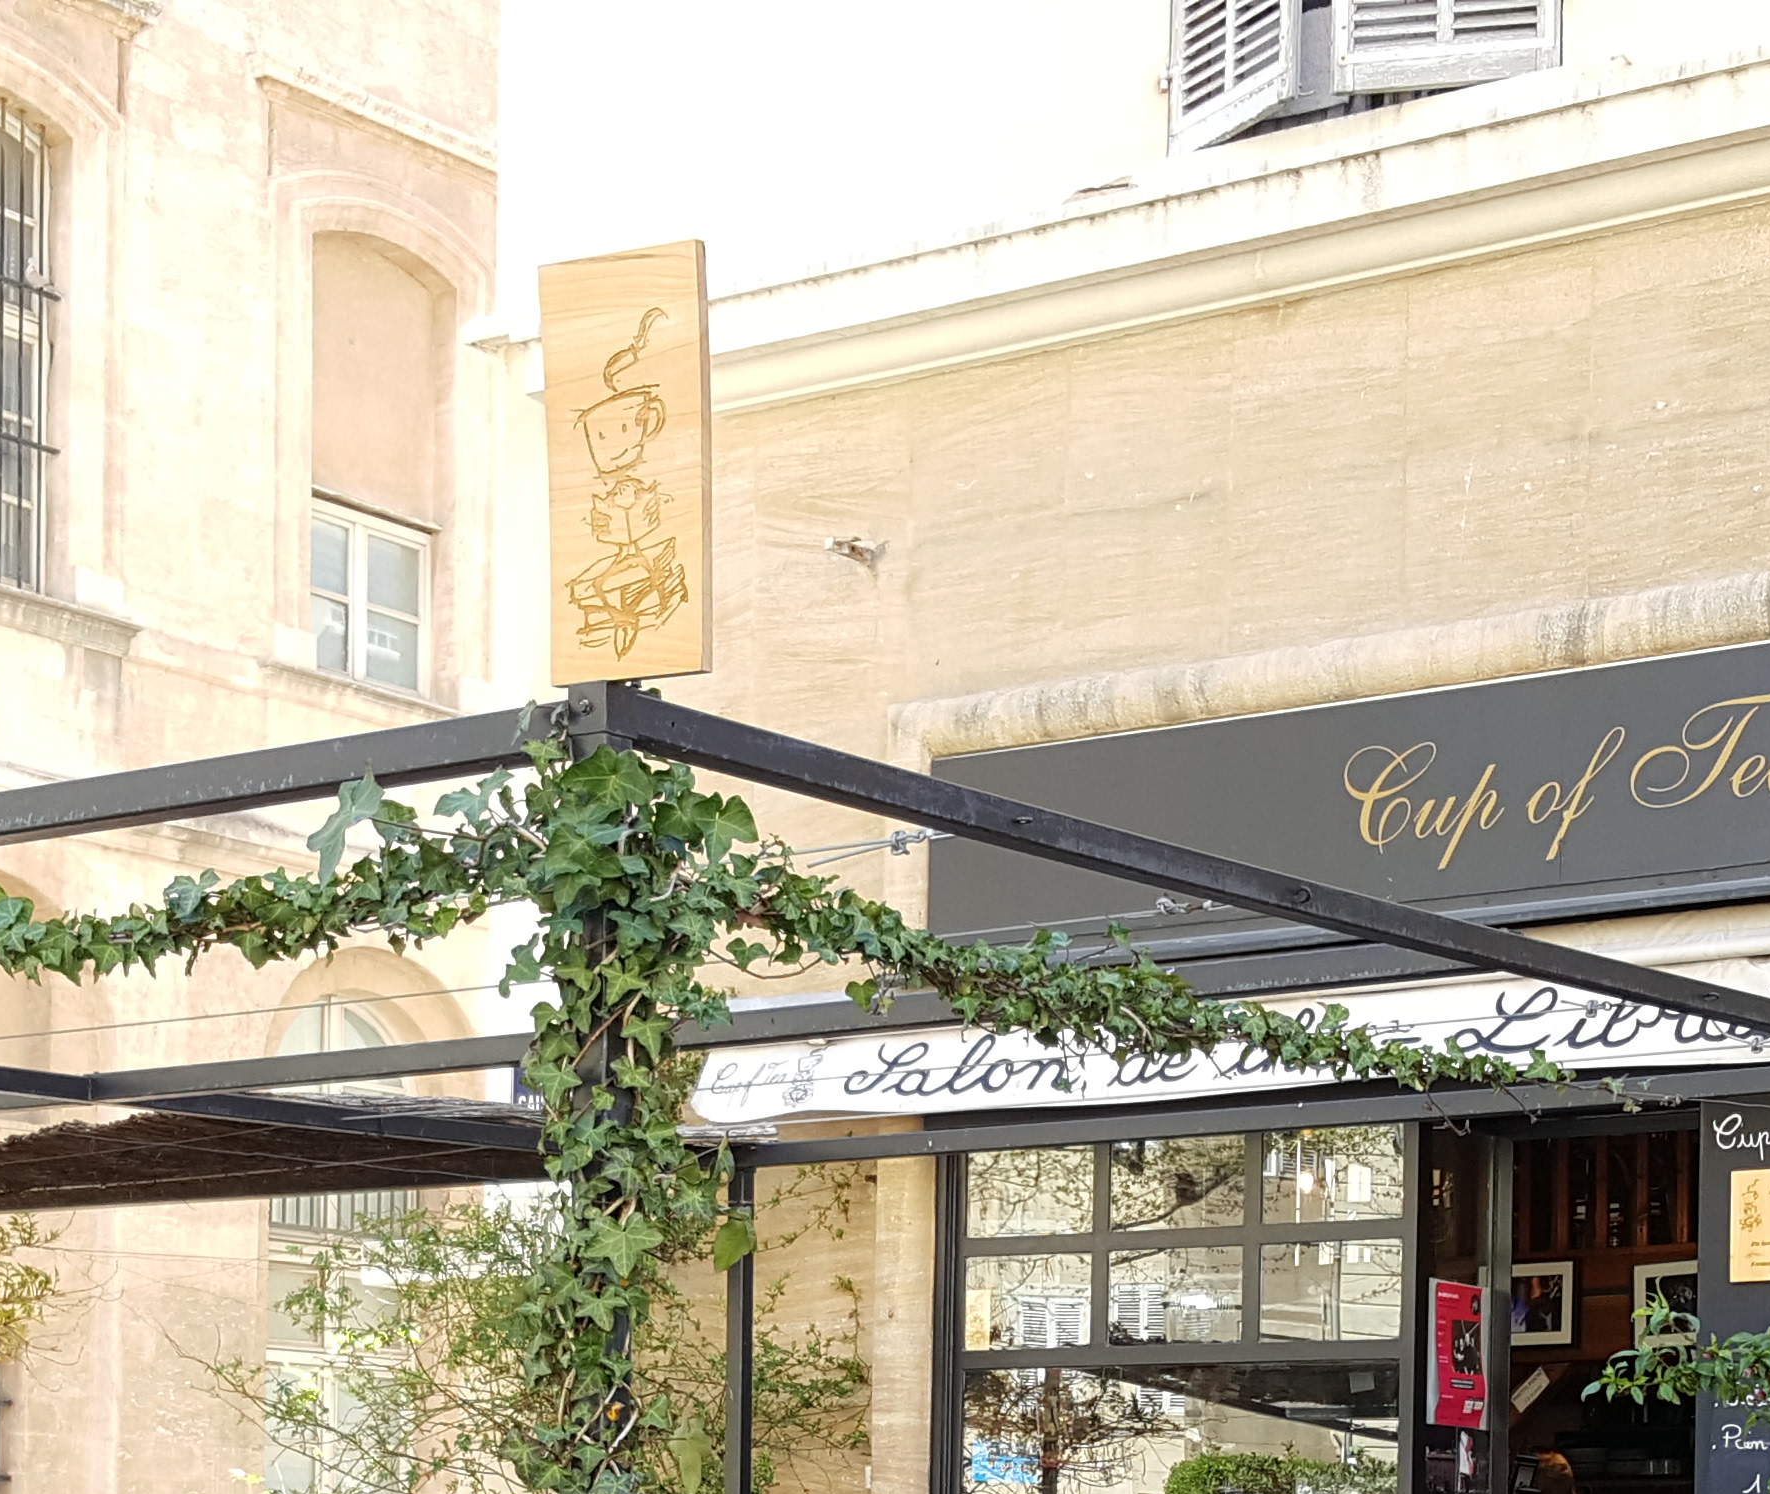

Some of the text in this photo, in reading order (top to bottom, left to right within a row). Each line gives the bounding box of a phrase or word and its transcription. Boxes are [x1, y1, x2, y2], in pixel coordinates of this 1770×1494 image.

[1343, 740, 1505, 871] Cup
[1525, 725, 1625, 862] of
[843, 1033, 1087, 1097] Salon
[1721, 1423, 1769, 1450] Pain
